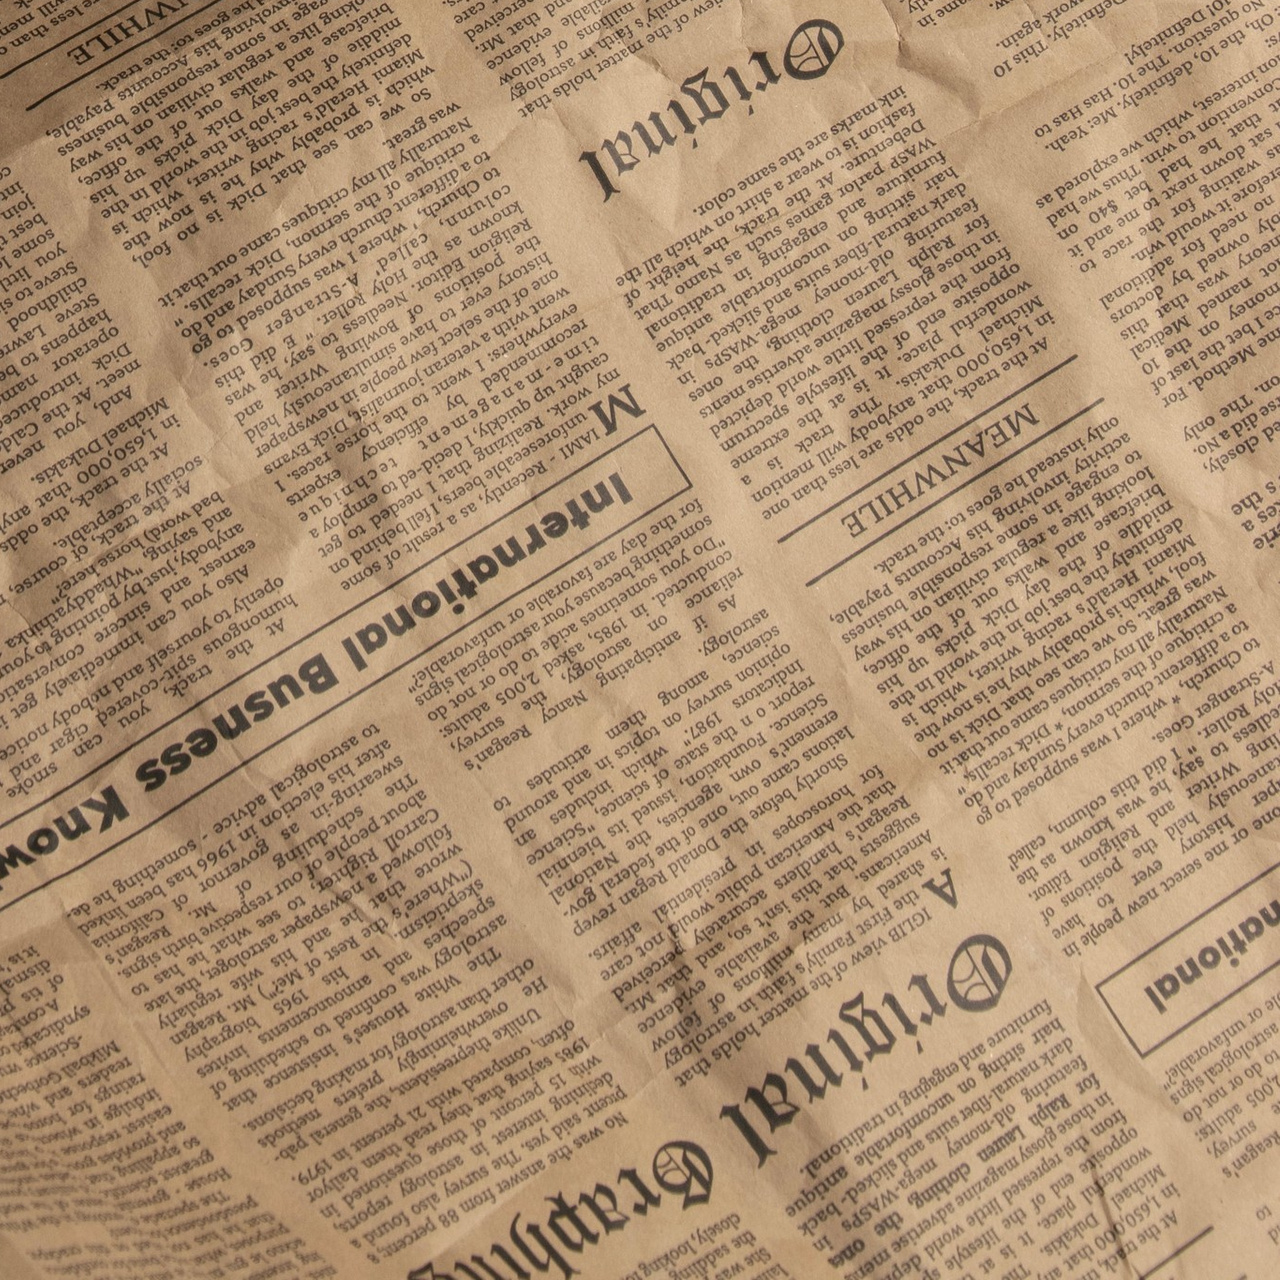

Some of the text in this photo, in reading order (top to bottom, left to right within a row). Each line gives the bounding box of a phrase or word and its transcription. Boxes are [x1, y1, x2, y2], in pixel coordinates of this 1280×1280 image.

[578, 19, 844, 203] Original
[587, 383, 646, 436] M
[761, 336, 1047, 519] At the track, the odds are less than one
[841, 403, 1040, 538] MEANWHILE
[341, 472, 633, 672] International
[135, 653, 339, 793] Busness
[922, 867, 957, 909] A
[1144, 899, 1280, 1014] national
[719, 934, 1012, 1169] Original
